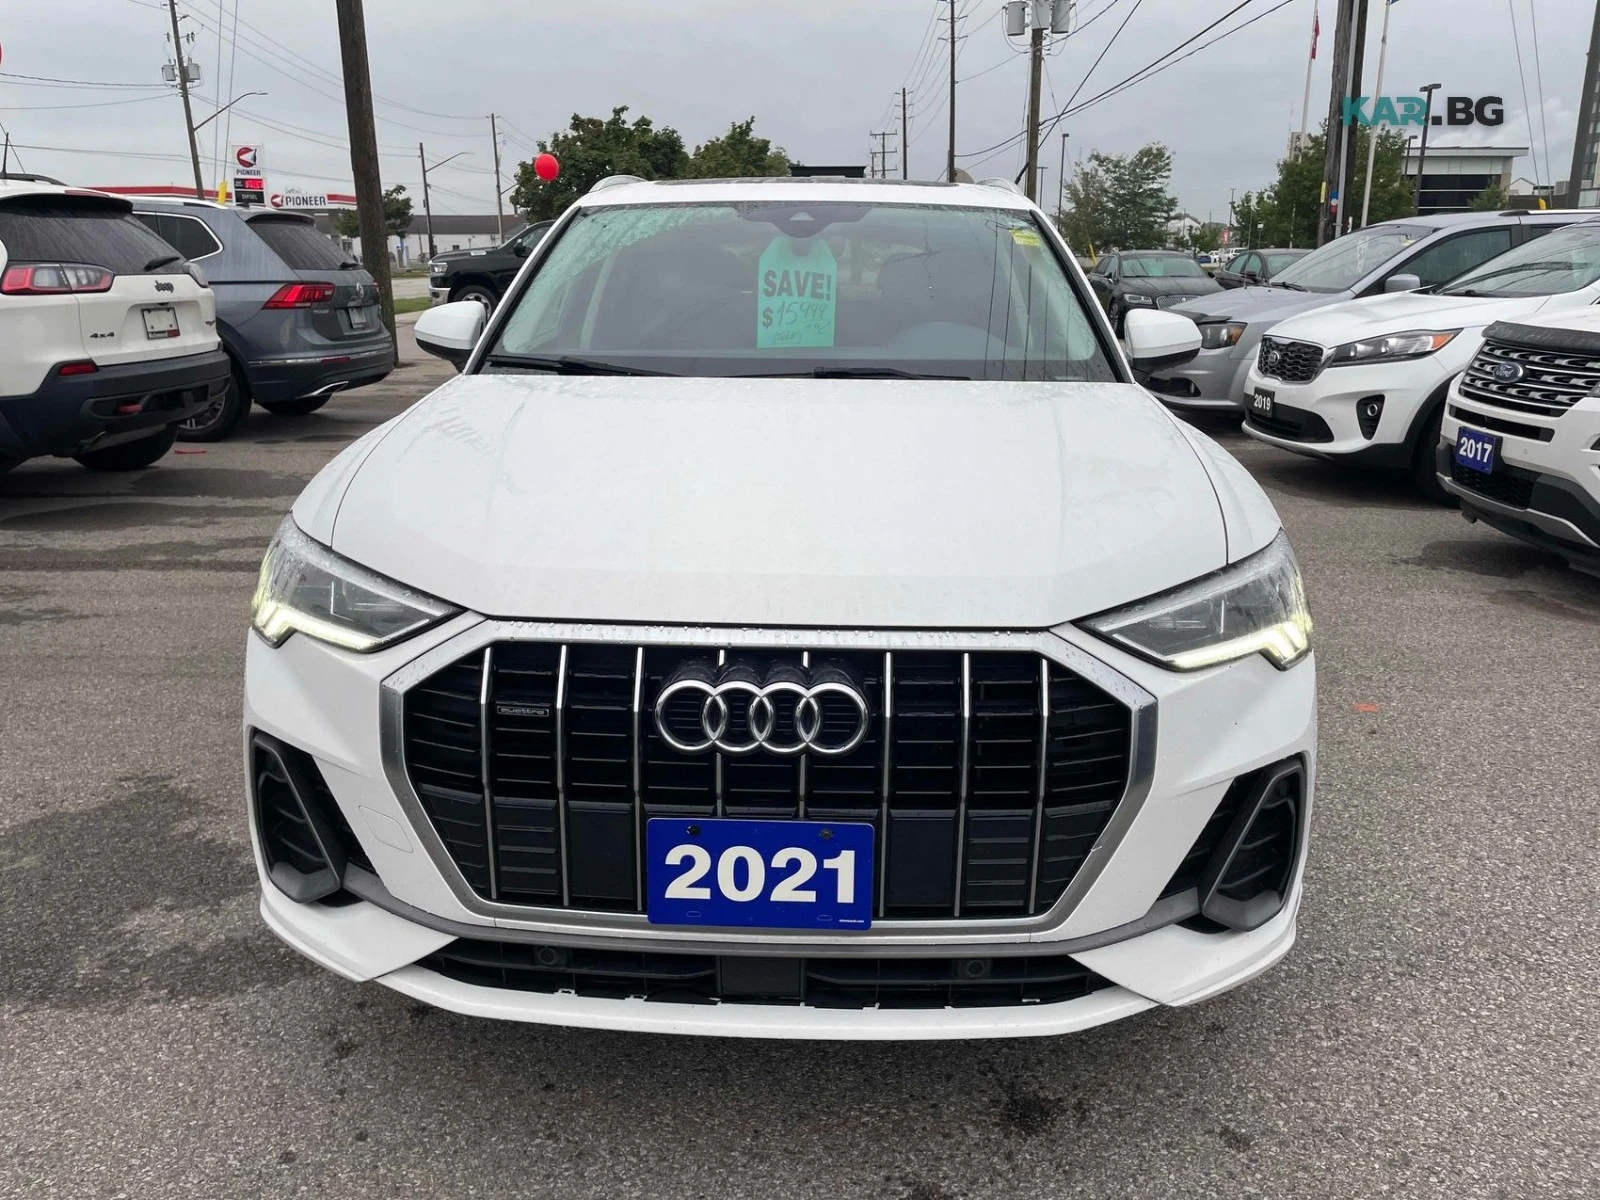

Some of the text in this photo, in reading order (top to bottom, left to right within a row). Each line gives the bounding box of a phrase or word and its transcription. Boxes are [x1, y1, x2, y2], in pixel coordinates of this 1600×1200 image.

[285, 196, 326, 206] PIONEER
[763, 269, 832, 301] SAVE!
[1254, 393, 1271, 411] 2019
[1459, 437, 1493, 463] 2017
[664, 843, 856, 904] 2021
